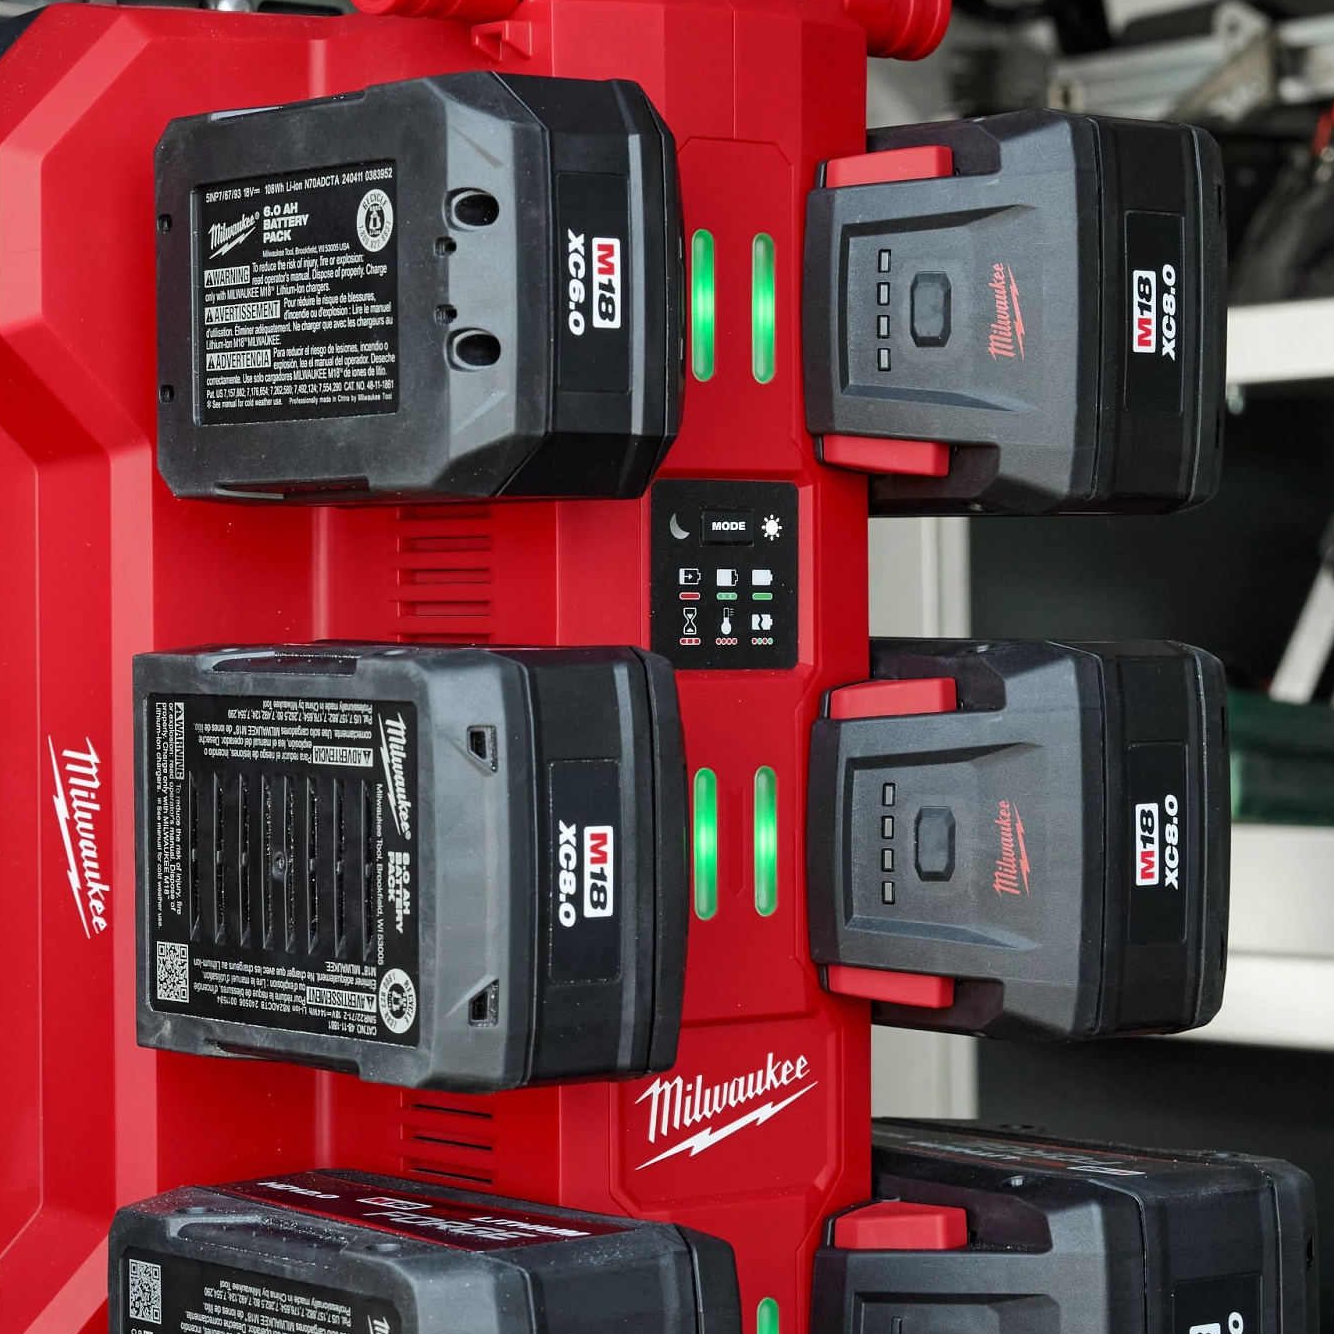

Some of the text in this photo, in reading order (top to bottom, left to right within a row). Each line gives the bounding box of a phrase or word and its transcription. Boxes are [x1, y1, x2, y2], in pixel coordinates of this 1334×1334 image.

[265, 183, 284, 194] 108Wh
[286, 181, 302, 192] Li-ion
[305, 175, 339, 189] N70ADCTA
[342, 172, 363, 184] 240411
[365, 168, 392, 181] 0383952
[264, 203, 298, 217] 6.0 AH
[264, 214, 309, 230] BATTERY
[208, 215, 255, 250] Milwaukee
[263, 230, 291, 243] PACK
[213, 268, 248, 286] WARNING
[252, 262, 258, 272] To
[259, 261, 276, 272] reduce
[277, 260, 286, 270] the
[287, 259, 296, 269] risk
[297, 258, 303, 268] of
[320, 257, 328, 266] fire
[329, 257, 335, 265] or
[252, 265, 387, 286] read operator's manual. Dispose of properly. Charge
[205, 292, 216, 303] only
[216, 290, 226, 300] with
[227, 287, 259, 299] MILWAUKEE
[277, 284, 305, 295] Lithium-Ion
[306, 283, 330, 294] chargers.
[568, 228, 585, 335] XC6.0
[596, 243, 616, 323] M18
[215, 303, 278, 322] AVERTISSEMENT
[988, 262, 1016, 361] Milwaukee
[1137, 275, 1153, 347] M18
[1162, 264, 1176, 361] XC8.0
[216, 351, 269, 369] ADVERTENCIA
[712, 521, 746, 530] MODE
[175, 720, 183, 778] WARNING
[315, 747, 361, 764] ADVERTENCIA
[385, 712, 411, 833] Milwaukee
[176, 783, 181, 793] To
[62, 736, 111, 935] Milwaukee
[993, 799, 1020, 896] Milwaukee
[1139, 808, 1155, 880] M18
[1165, 794, 1178, 890] XC8.0
[176, 862, 182, 871] of
[559, 819, 577, 927] XC8.0
[589, 832, 608, 911] M18
[395, 852, 403, 933] BATTERY
[403, 888, 410, 914] AH
[171, 902, 176, 911] of
[377, 919, 383, 932] WI
[307, 987, 365, 1011] AVERTISSEMENT
[635, 1053, 810, 1144] Milwaukee
